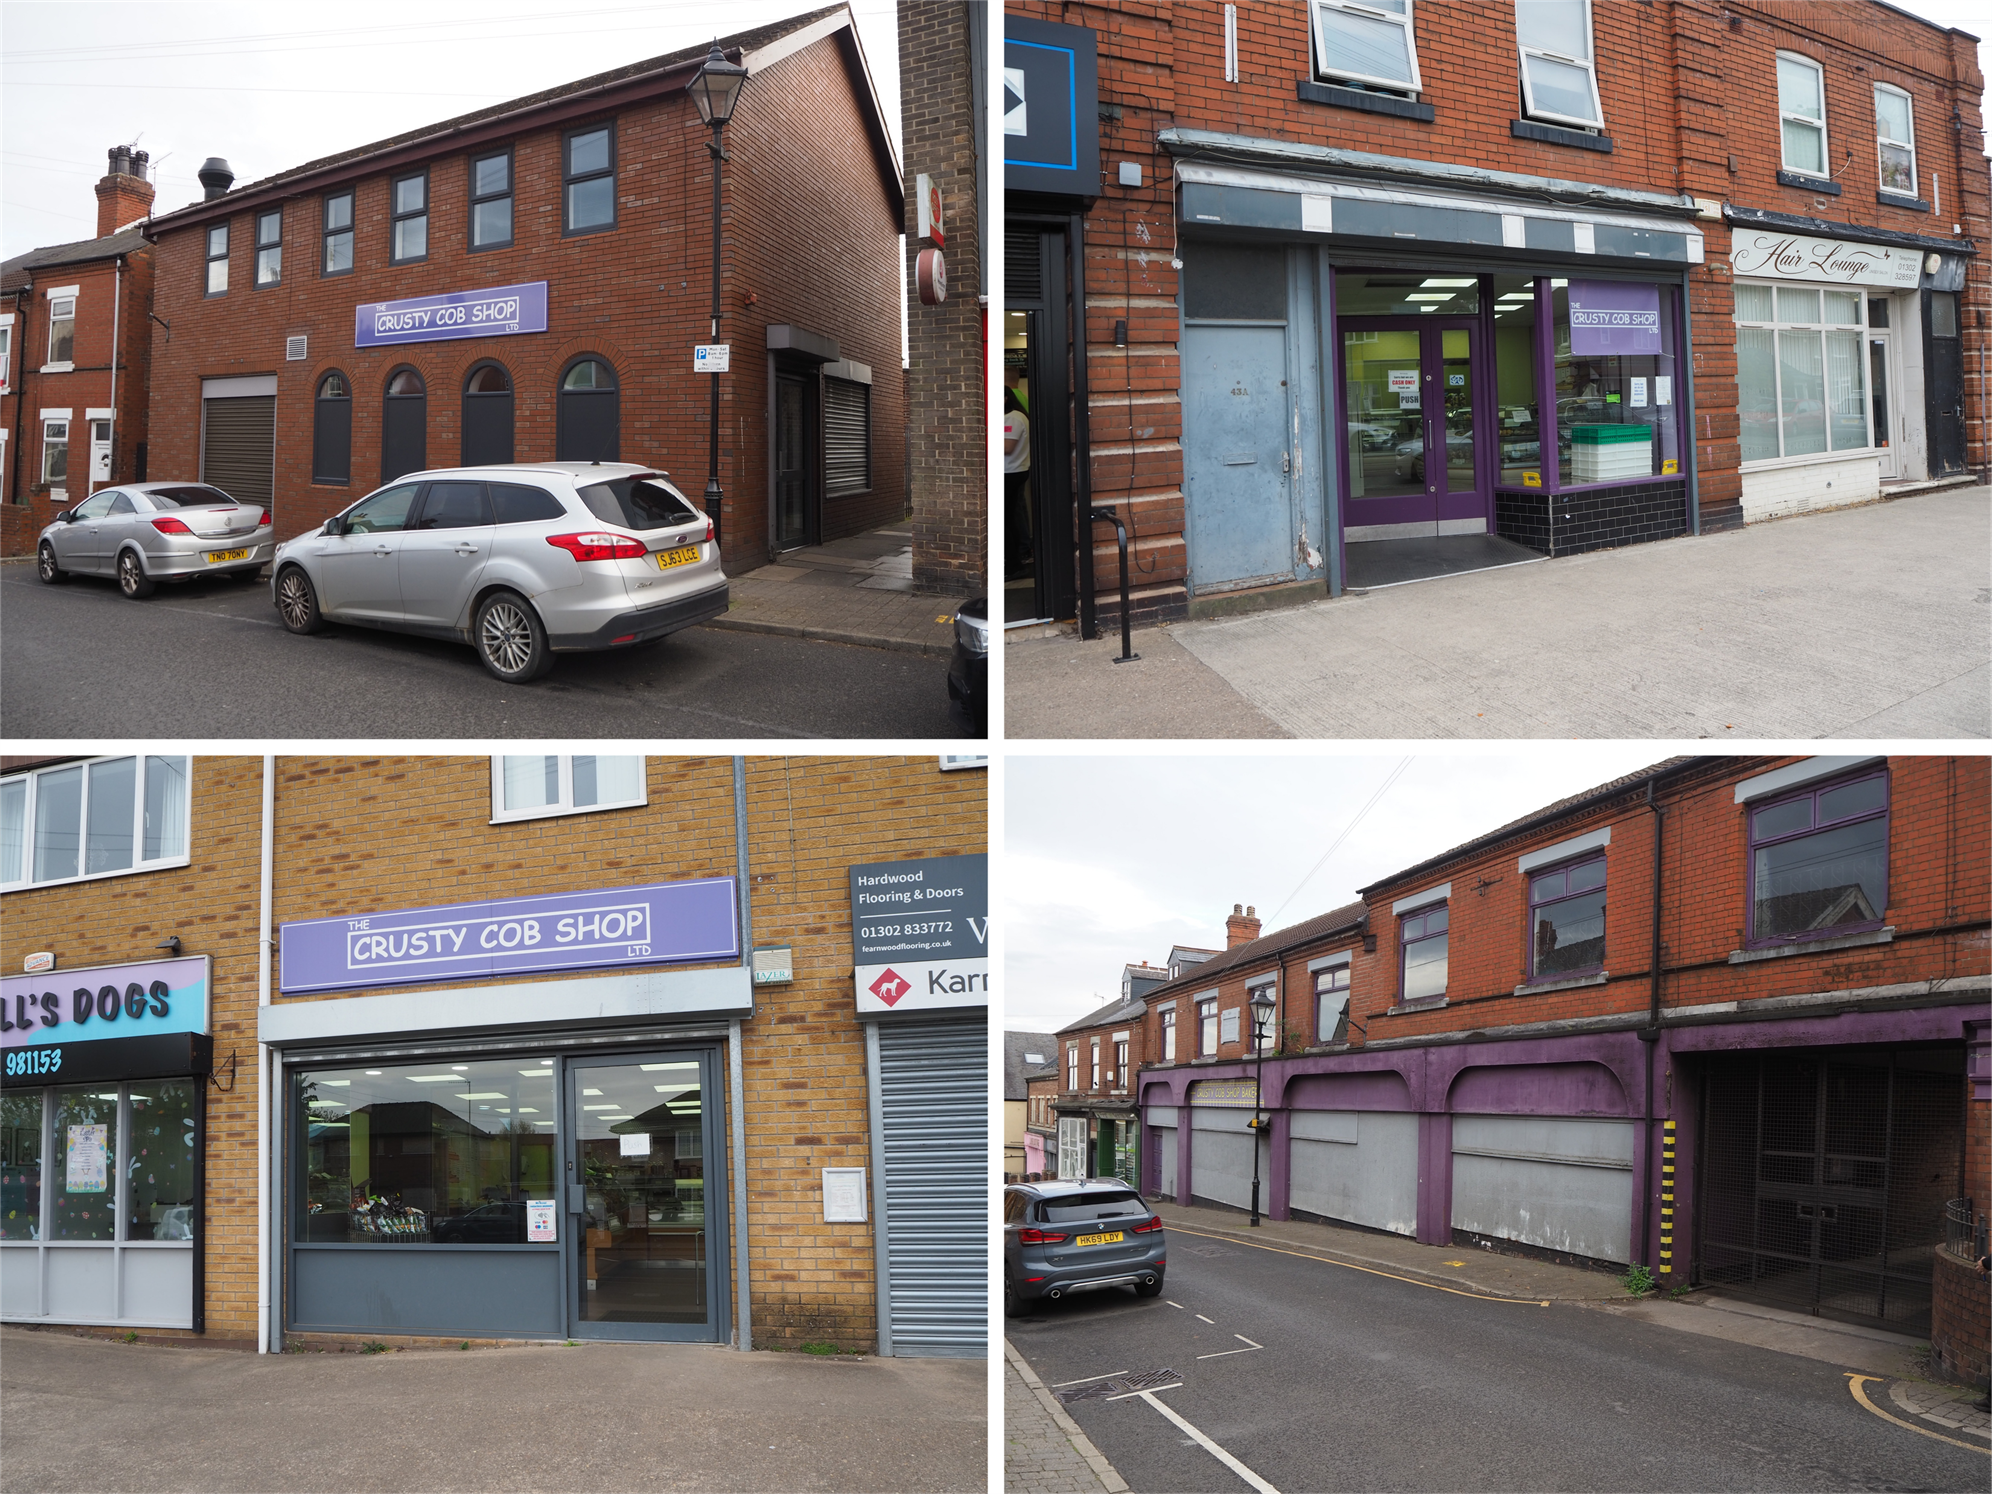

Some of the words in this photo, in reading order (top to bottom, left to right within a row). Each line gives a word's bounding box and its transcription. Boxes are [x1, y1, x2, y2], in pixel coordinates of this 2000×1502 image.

[1734, 236, 1808, 275] Hair
[1809, 244, 1869, 280] Lounge
[1898, 263, 1916, 272] 01302
[378, 311, 430, 331] CRUSTY
[436, 308, 466, 325] COB
[472, 301, 516, 322] SHOP
[1573, 312, 1609, 324] CRUSTY
[1612, 314, 1630, 324] COB
[1632, 314, 1656, 324] SHOP
[1401, 396, 1418, 404] PUSH
[660, 552, 681, 566] SJ63
[684, 548, 698, 562] LCE
[858, 870, 924, 886] Hardwood
[859, 890, 912, 904] Flooring
[914, 890, 924, 900] &
[926, 887, 964, 898] Doors
[348, 919, 370, 931] THE
[861, 925, 902, 938] 01302
[904, 921, 953, 935] 833772
[354, 927, 466, 961] CRUSTY
[480, 919, 541, 949] COB
[555, 910, 644, 944] SHOP
[628, 945, 651, 957] LTD
[862, 940, 952, 952] fearnwoodflooring.co.uk
[73, 980, 169, 1024] DOGS
[6, 1048, 62, 1076] 981153
[1197, 1088, 1214, 1098] CRUSTY
[1215, 1088, 1225, 1098] COB
[1226, 1087, 1240, 1098] SHOP
[1080, 1235, 1102, 1244] HK69
[1105, 1233, 1119, 1242] LDY
